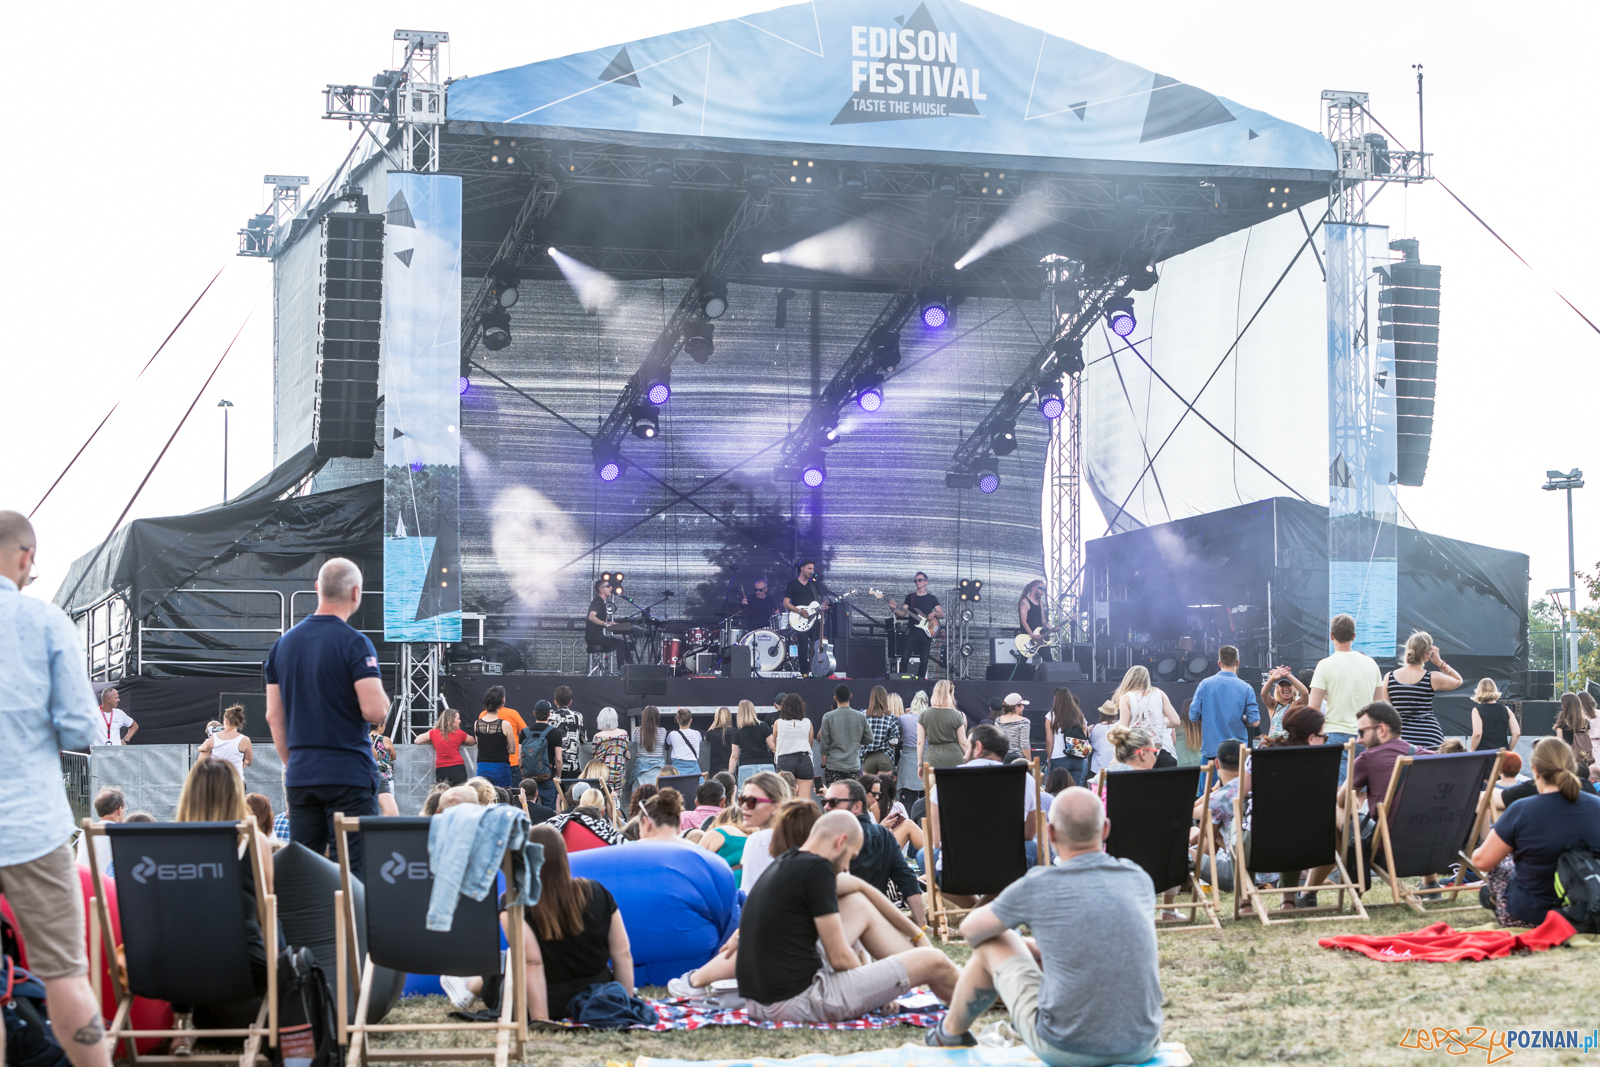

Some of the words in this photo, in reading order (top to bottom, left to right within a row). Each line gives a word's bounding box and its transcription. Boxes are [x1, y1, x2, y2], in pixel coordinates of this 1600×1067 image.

[852, 26, 957, 63] EDISON
[852, 61, 987, 100] FESTIVAL
[852, 98, 886, 113] TASTE
[888, 101, 909, 114] THE
[912, 102, 946, 116] MUSIC
